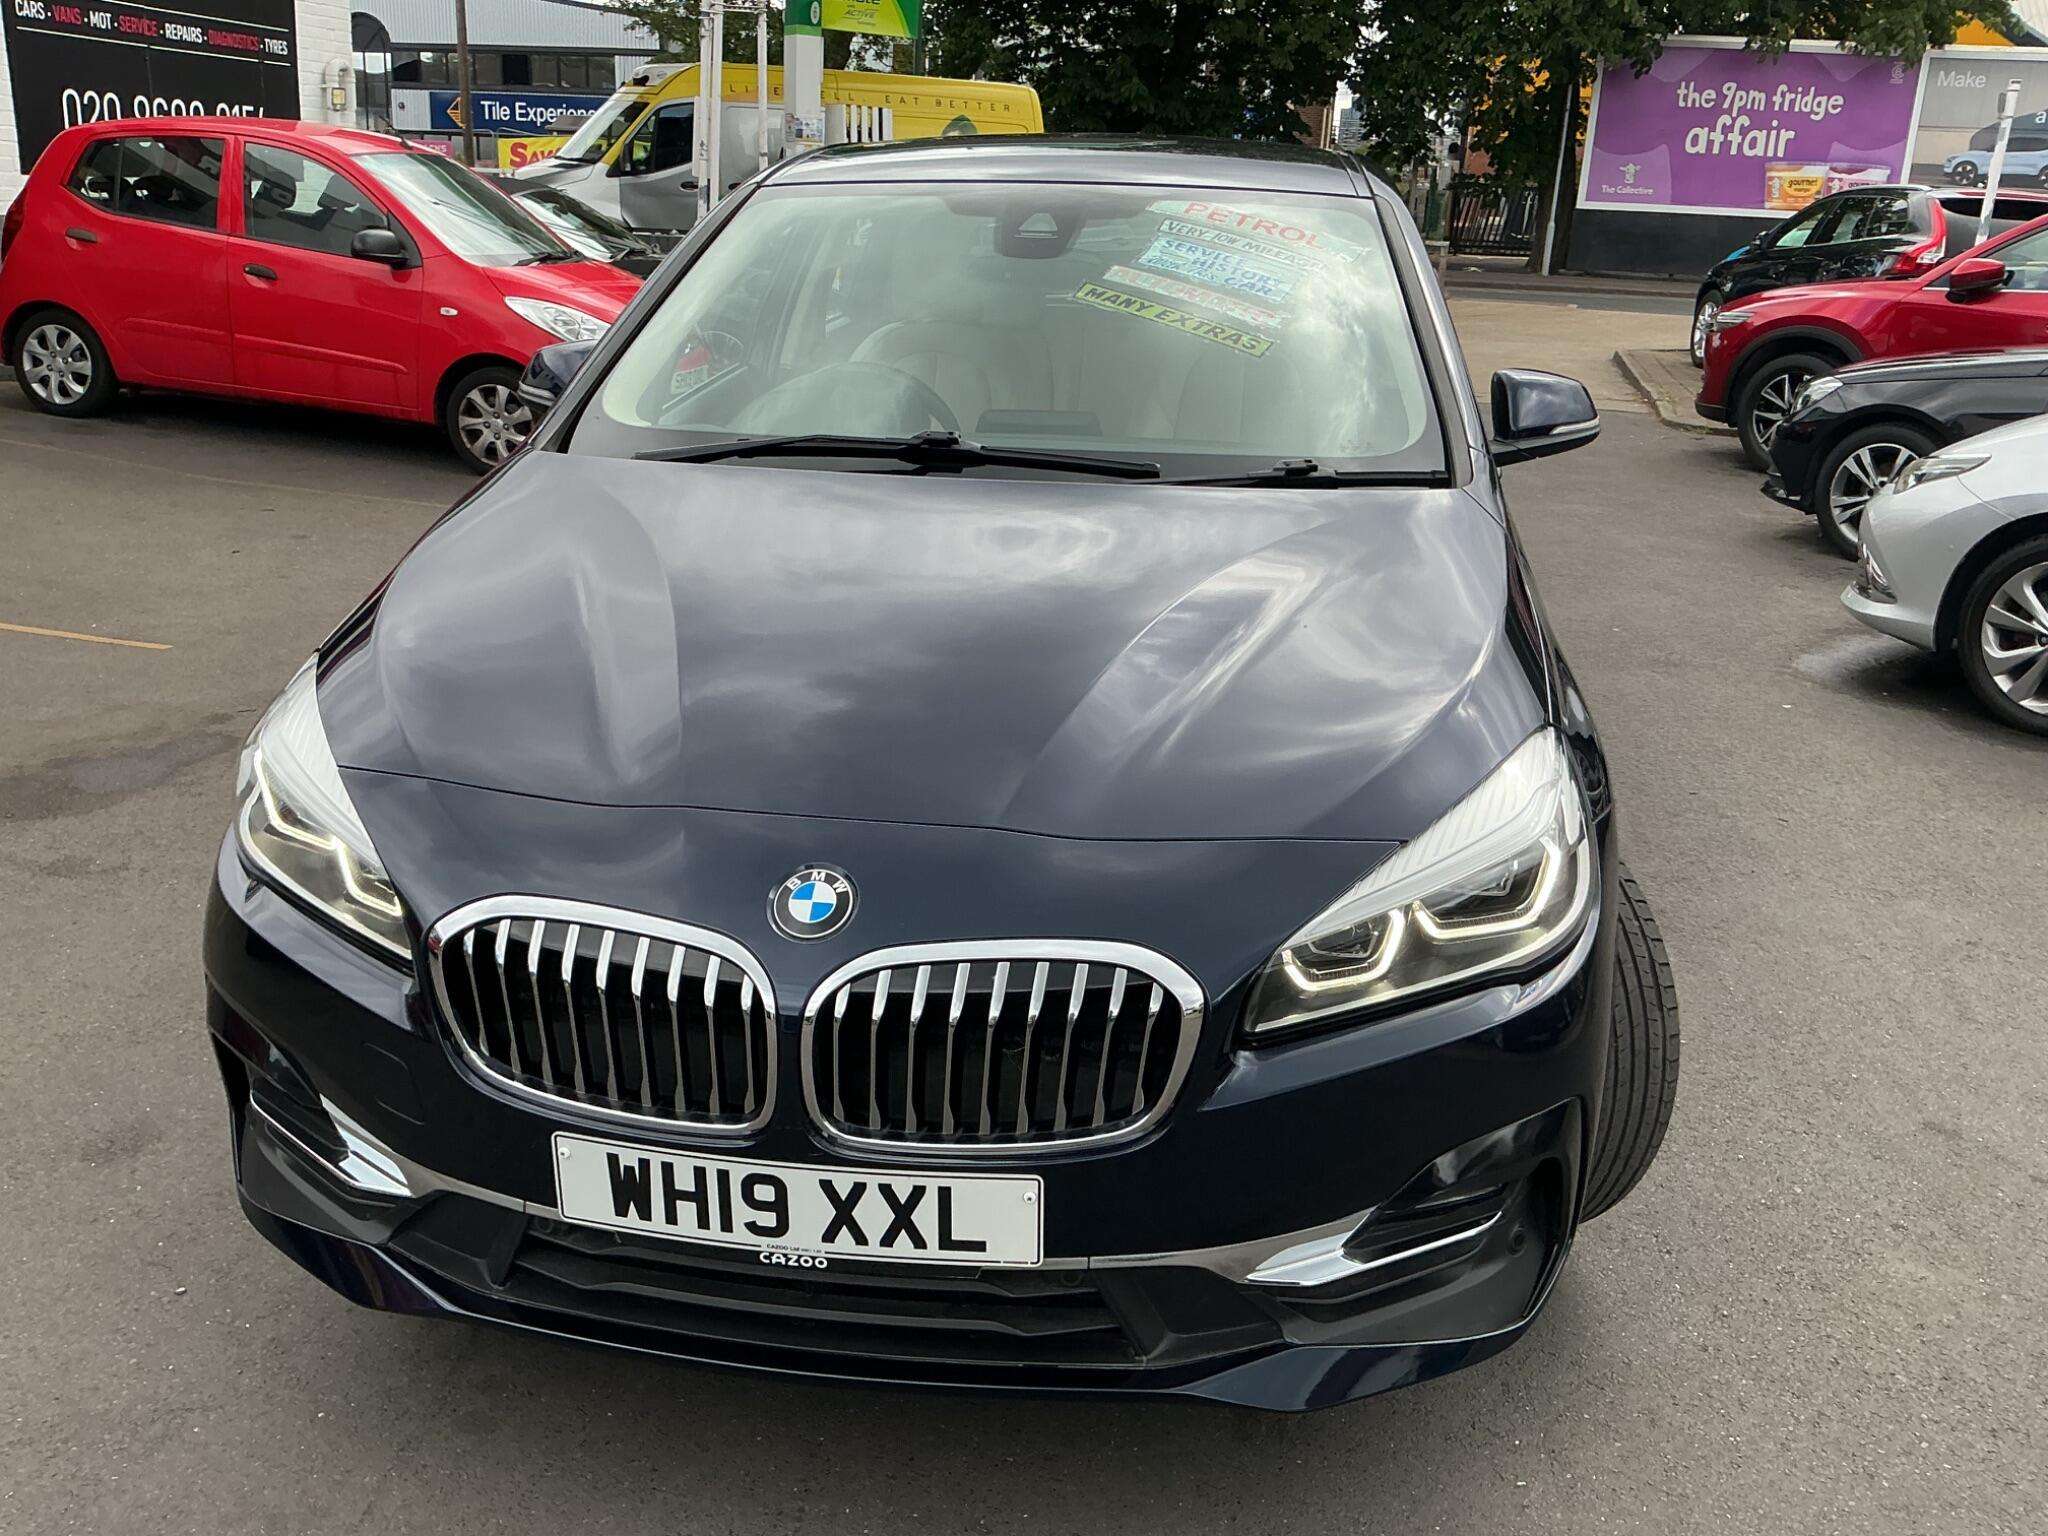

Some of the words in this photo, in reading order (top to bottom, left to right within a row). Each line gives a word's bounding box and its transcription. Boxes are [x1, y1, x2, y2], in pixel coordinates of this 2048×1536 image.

[15, 0, 45, 19] CARS
[52, 5, 81, 25] VANS
[89, 11, 112, 29] MOT
[119, 15, 158, 37] SERVICE
[165, 23, 202, 43] REPAIRS
[208, 29, 259, 51] DIAGNOSTICS
[264, 38, 288, 55] TYRES
[1937, 70, 1987, 88] Make
[730, 84, 780, 96] LIE
[886, 95, 920, 106] EAT
[1677, 81, 1716, 108] the
[1722, 82, 1766, 117] 9pm
[1773, 84, 1845, 121] fridge
[480, 100, 510, 120] Tile
[1684, 114, 1796, 158] affair
[1601, 185, 1615, 193] The
[1616, 185, 1654, 195] Collective
[1788, 179, 1818, 188] gourmet
[1167, 221, 1209, 237] VERY
[1184, 201, 1326, 249] PETROL
[1161, 240, 1246, 266] SERVICE
[1191, 257, 1280, 287] HISTORY
[1224, 277, 1273, 295] CAR
[1083, 287, 1153, 313] MANY
[1153, 309, 1262, 350] EXTRAS
[786, 870, 848, 894] BMW
[606, 1152, 789, 1238] WH19
[818, 1178, 987, 1252] XXL
[759, 1252, 828, 1269] CAZOO
